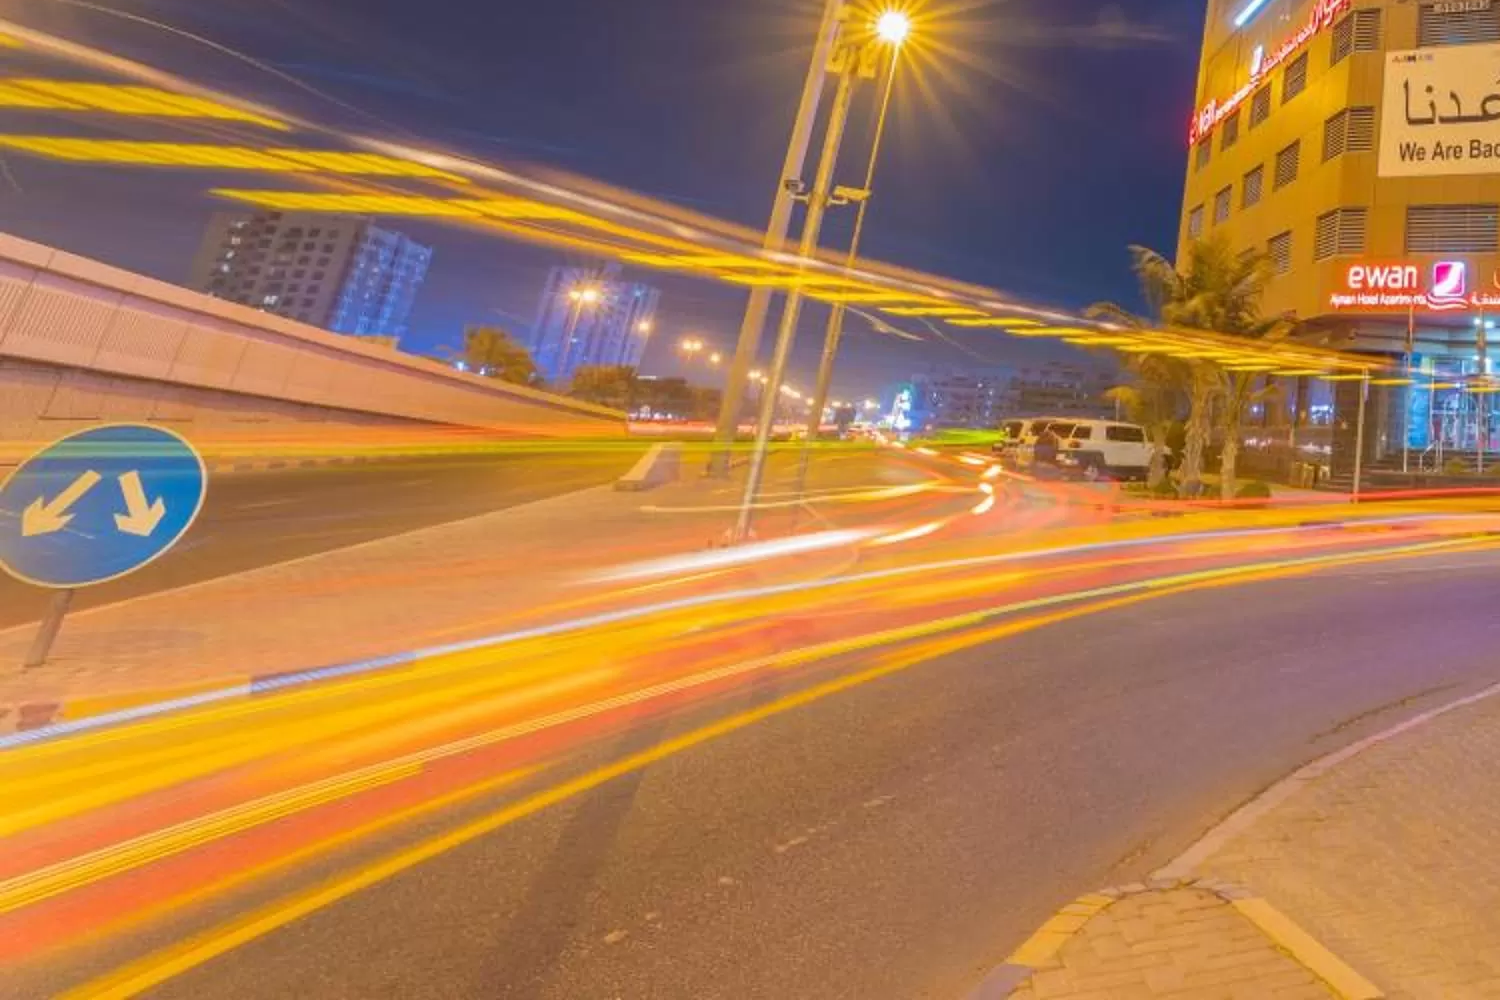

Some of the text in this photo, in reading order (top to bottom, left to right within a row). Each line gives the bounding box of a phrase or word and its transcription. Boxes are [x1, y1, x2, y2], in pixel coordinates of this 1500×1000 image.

[1399, 141, 1427, 161] We
[1431, 140, 1463, 161] Are
[1348, 264, 1418, 289] ewan
